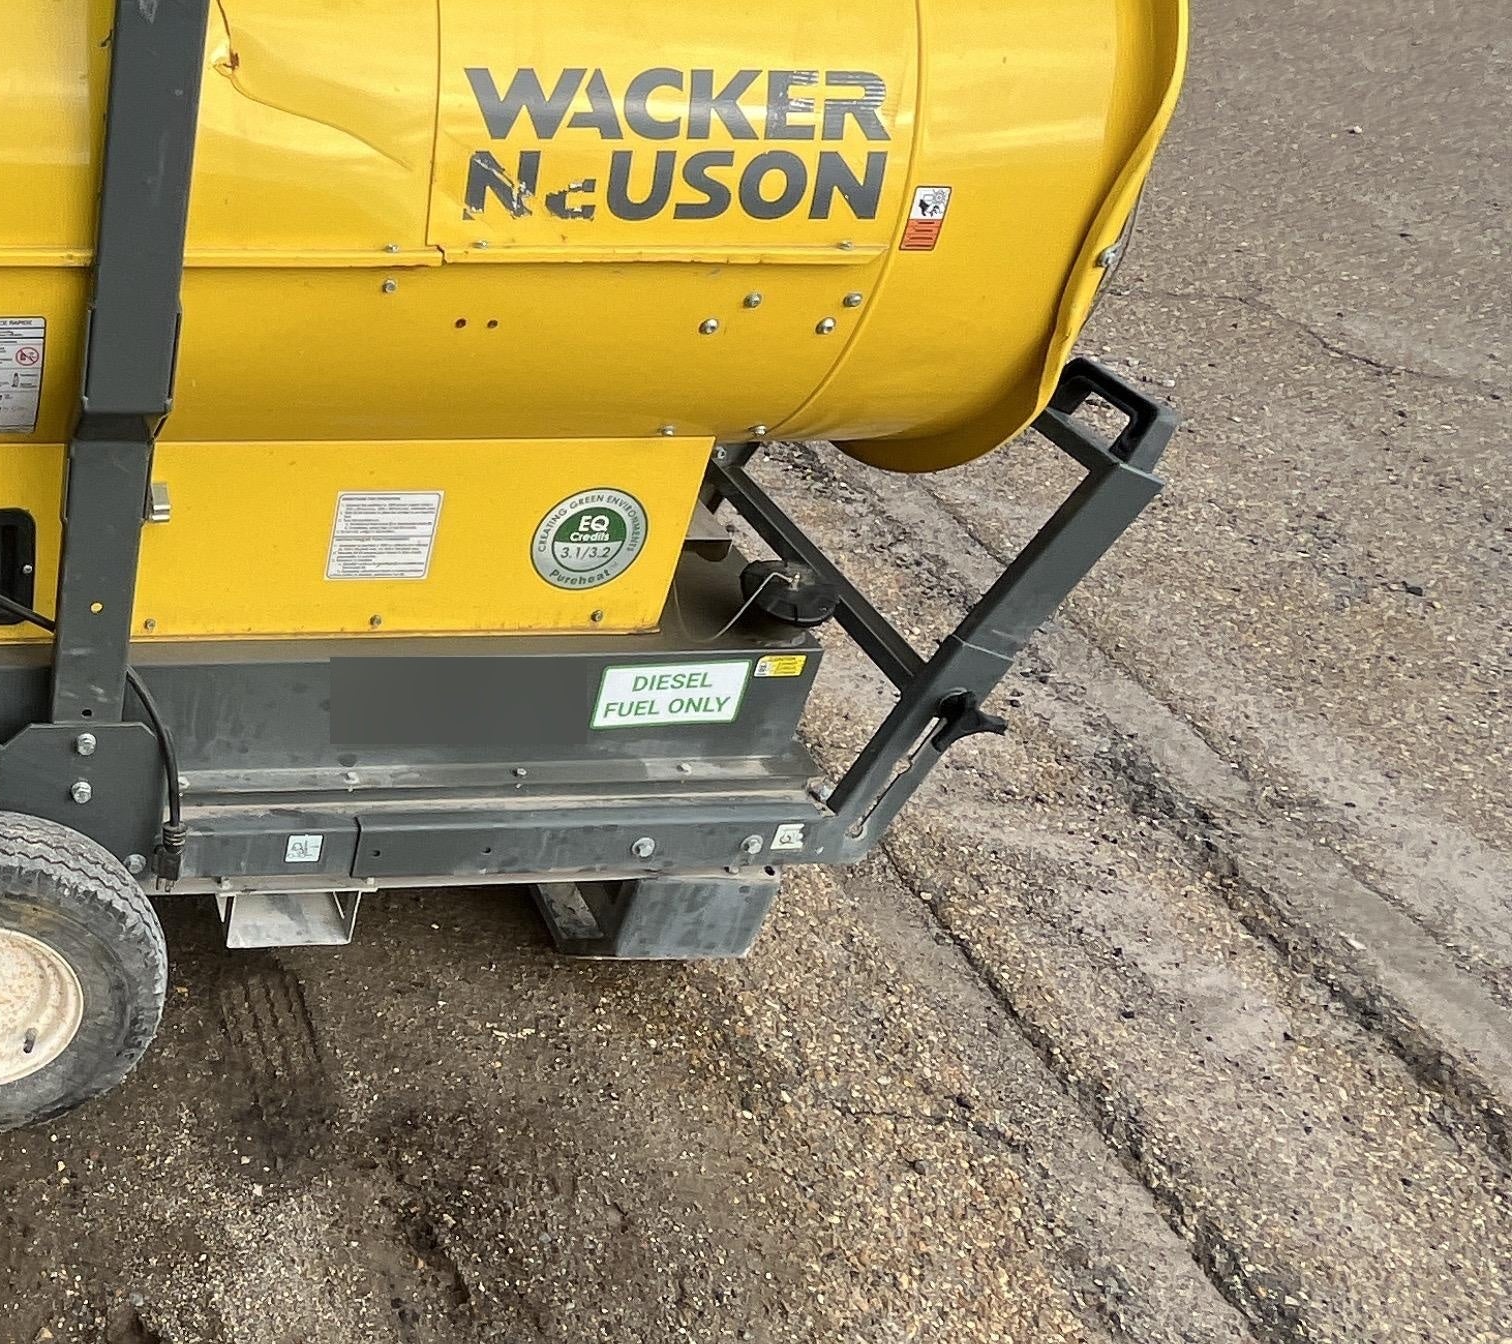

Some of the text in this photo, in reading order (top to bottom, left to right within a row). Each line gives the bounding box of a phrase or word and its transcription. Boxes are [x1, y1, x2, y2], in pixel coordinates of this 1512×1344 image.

[463, 67, 892, 142] WACKER
[537, 508, 568, 553] CREATING
[569, 494, 605, 510] GREEN
[578, 514, 610, 532] EQ
[569, 531, 610, 542] Credits
[560, 546, 611, 560] 3.1/3.2
[631, 671, 714, 693] DIESEL
[602, 695, 732, 719] FUEL ONLY
